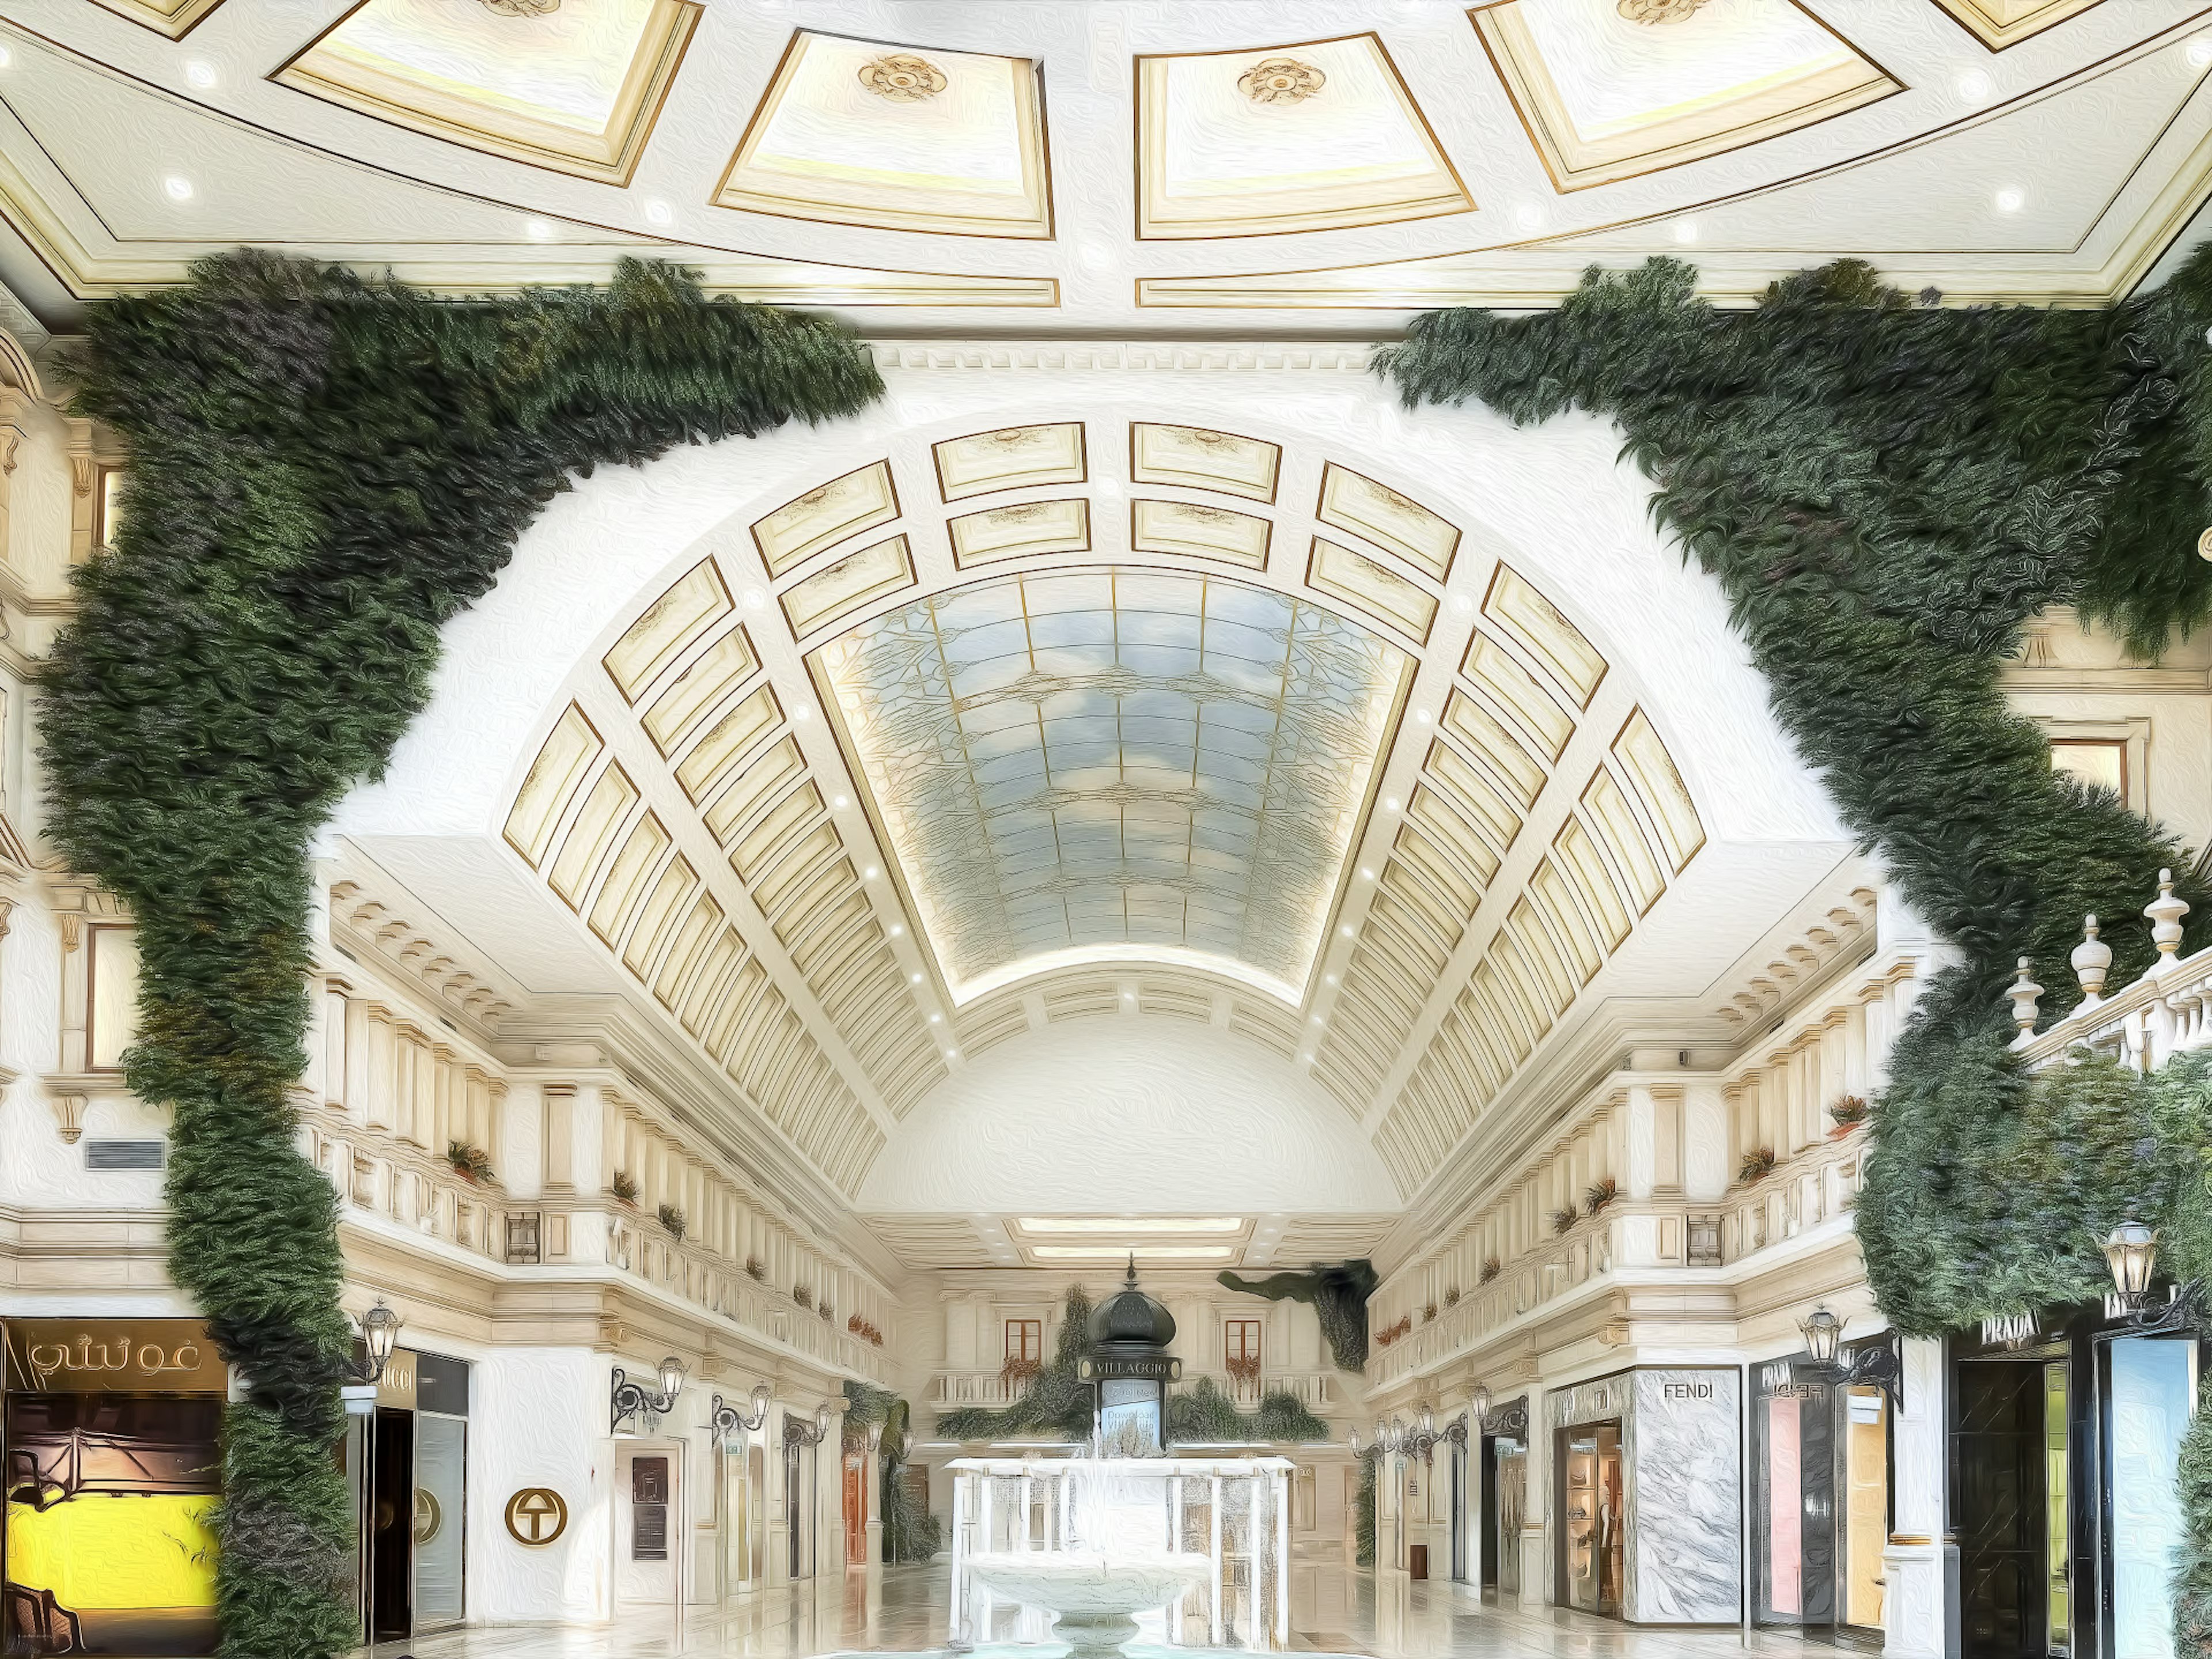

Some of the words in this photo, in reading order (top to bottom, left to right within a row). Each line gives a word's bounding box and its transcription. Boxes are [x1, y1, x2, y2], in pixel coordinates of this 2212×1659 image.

[31, 1334, 202, 1376] غوتشي
[1097, 1362, 1166, 1374] VILLAGGIO
[1664, 1384, 1713, 1399] FENDI
